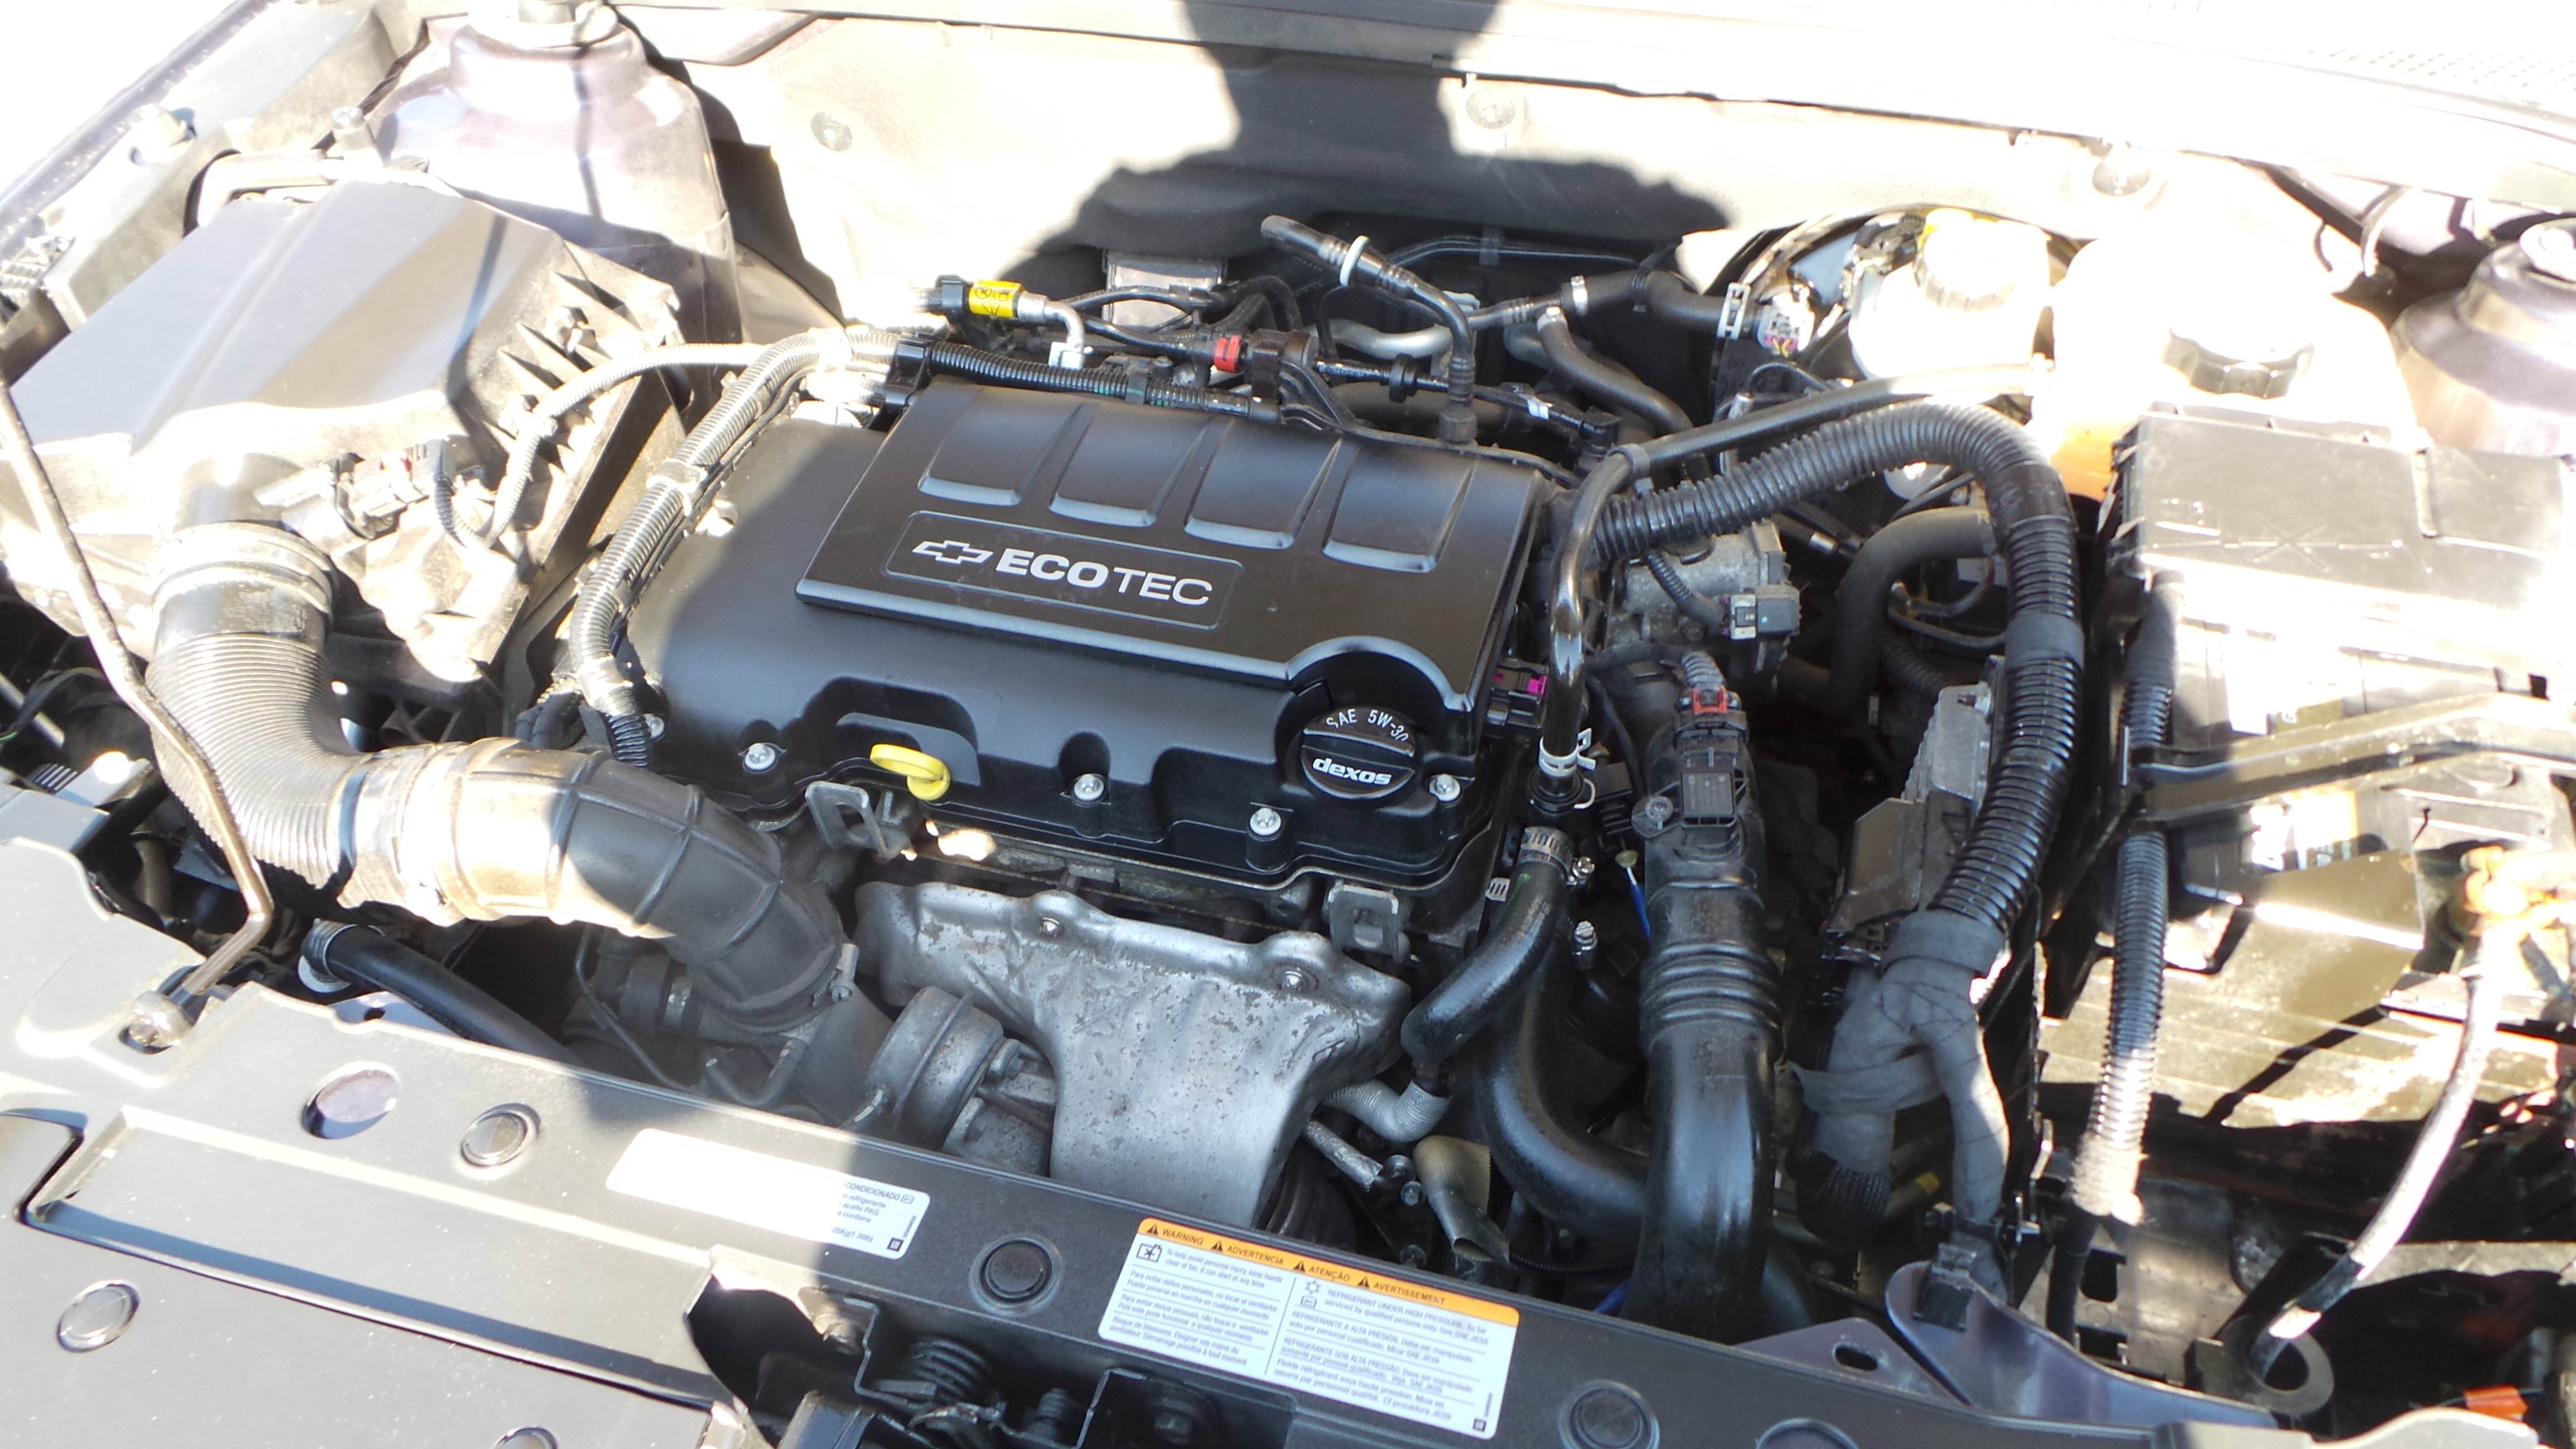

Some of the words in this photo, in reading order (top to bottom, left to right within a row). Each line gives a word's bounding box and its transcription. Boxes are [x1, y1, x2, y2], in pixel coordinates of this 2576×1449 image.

[995, 548, 1213, 606] ECOTEC
[1326, 708, 1357, 729] SAE
[1312, 758, 1392, 785] dexos
[843, 1182, 900, 1200] CONDICIONADO
[843, 1213, 872, 1223] contiene
[1163, 1229, 1203, 1245] WARNING
[1227, 1246, 1283, 1265] ADVERTENCIA
[1309, 1266, 1350, 1281] ATENÇÃO
[1374, 1282, 1445, 1303] AVERTISSEMENT
[1174, 1251, 1187, 1260] help
[1187, 1255, 1204, 1263] avoid
[1204, 1259, 1229, 1270] personal
[1248, 1270, 1263, 1279] keep
[1264, 1273, 1282, 1283] hands
[1218, 1272, 1232, 1280] start
[1127, 1279, 1145, 1289] Puede
[1146, 1285, 1170, 1295] ponerse
[1180, 1294, 1202, 1304] marcha
[1212, 1302, 1239, 1313] cualquier
[1240, 1309, 1269, 1320] momento
[1130, 1270, 1144, 1279] Para
[1162, 1279, 1180, 1288] daños
[1181, 1284, 1214, 1297] personales,
[1225, 1294, 1240, 1303] tocar
[1121, 1294, 1135, 1303] Para
[1136, 1299, 1153, 1307] evitar
[1214, 1317, 1230, 1327] toque
[1325, 1300, 1353, 1311] serviced
[1364, 1310, 1393, 1321] qualified
[1394, 1317, 1421, 1328] persons
[1328, 1290, 1376, 1306] REFRIGERANT
[1378, 1303, 1403, 1314] UNDER
[1405, 1309, 1423, 1318] HIGH
[1112, 1316, 1133, 1327] Risque
[1211, 1342, 1230, 1352] mains
[1117, 1302, 1131, 1311] Pois
[1145, 1310, 1161, 1318] pode
[1197, 1323, 1223, 1333] qualquer
[1224, 1330, 1253, 1342] momento
[1292, 1311, 1342, 1328] REFRIGERANTE
[1350, 1325, 1366, 1335] ALTA
[1401, 1338, 1419, 1349] Debe
[1433, 1348, 1472, 1363] manipulado
[1317, 1328, 1346, 1340] personal
[1176, 1343, 1201, 1353] possible
[1208, 1350, 1221, 1359] tout
[1221, 1355, 1247, 1366] moment
[1277, 1358, 1299, 1370] Fluide
[1339, 1376, 1357, 1386] sous
[1358, 1380, 1379, 1391] haute
[1415, 1395, 1433, 1405] Mise
[1313, 1380, 1349, 1393] personnel
[1393, 1401, 1429, 1415] procédure
